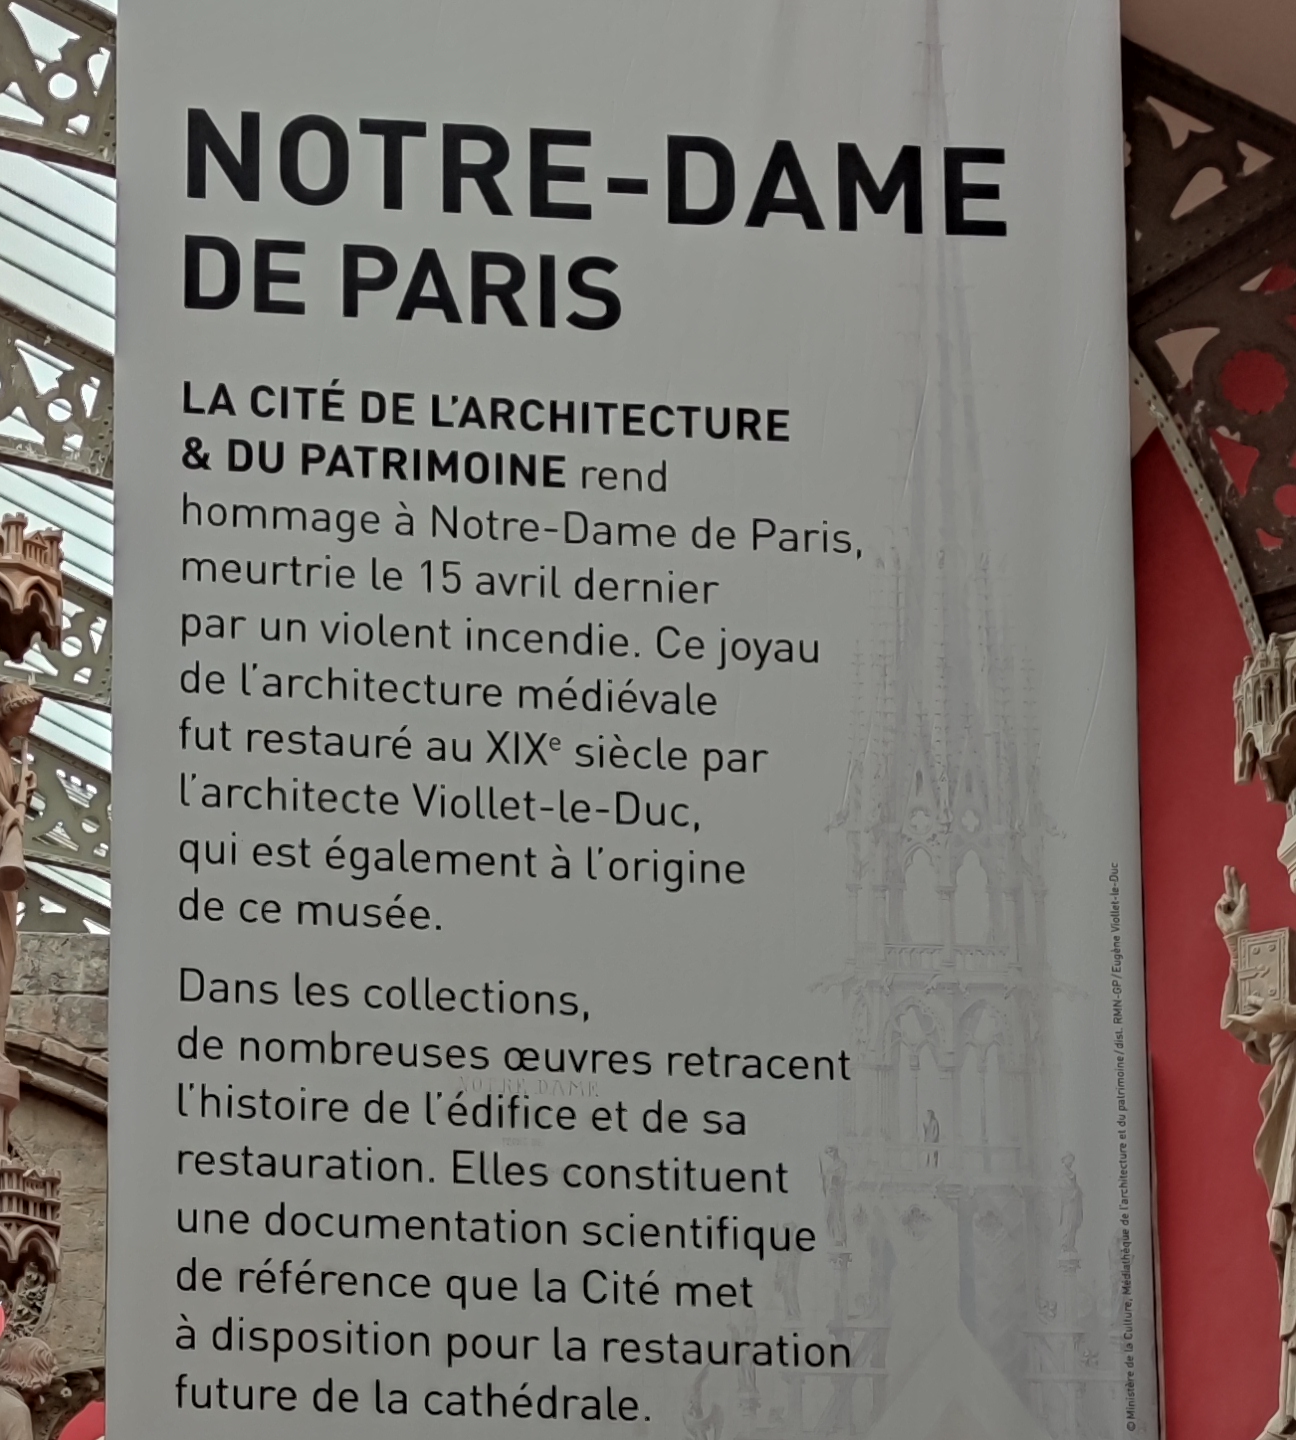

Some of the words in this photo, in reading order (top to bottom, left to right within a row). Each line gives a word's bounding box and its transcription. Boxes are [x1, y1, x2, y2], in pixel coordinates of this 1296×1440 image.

[187, 108, 1007, 237] NOTRE-DAME
[184, 234, 306, 315] DE
[342, 243, 622, 331] PARIS
[183, 380, 237, 416] LA
[250, 378, 345, 422] CITÉ
[361, 390, 415, 426] DE
[431, 394, 790, 442] L'ARCHITECTURE
[181, 436, 212, 471] &
[228, 438, 284, 474] DU
[301, 443, 566, 488] PATRIMOINE
[581, 459, 667, 492] rend
[182, 491, 380, 543] hommage
[395, 501, 414, 537] à
[432, 504, 677, 548] Notre-Dame
[691, 516, 736, 550] de
[752, 518, 862, 560] Paris,
[182, 554, 355, 589] meurtrie
[371, 556, 403, 591] le
[420, 559, 461, 594] 15
[475, 565, 561, 599] avril
[574, 567, 720, 605] dernier
[181, 613, 247, 647] par
[261, 617, 306, 643] un
[320, 611, 451, 650] violent
[466, 622, 640, 658] incendie.
[656, 625, 705, 660] Ce
[717, 637, 819, 671] joyau
[180, 660, 225, 695] de
[241, 662, 503, 708] l'architecture
[518, 675, 717, 716] médiévale
[178, 716, 232, 752] fut
[247, 724, 412, 760] restauré
[426, 737, 472, 763] au
[575, 733, 688, 771] siècle
[704, 748, 769, 782] par
[180, 772, 399, 816] l'architecte
[412, 783, 700, 833] Viollet-le-Duc,
[179, 839, 236, 874] qui
[252, 837, 311, 869] est
[325, 834, 537, 881] également
[550, 843, 570, 879] à
[587, 846, 745, 893] l'origine
[178, 886, 224, 922] de
[239, 898, 282, 924] ce
[297, 893, 442, 931] musée.
[1109, 862, 1121, 933] Viollet-le-Duc
[180, 967, 279, 1005] Dans
[294, 971, 350, 1008] les
[364, 976, 589, 1023] collections,
[177, 1025, 224, 1060] de
[240, 1030, 490, 1070] nombreuses
[504, 1046, 652, 1076] œuvres
[667, 1046, 851, 1081] retracent
[178, 1082, 349, 1123] l'histoire
[364, 1089, 410, 1125] de
[425, 1090, 577, 1131] l'édifice
[591, 1101, 628, 1133] et
[642, 1099, 688, 1134] de
[703, 1110, 746, 1136] sa
[1116, 1114, 1127, 1127] du
[1117, 1129, 1127, 1140] et
[178, 1145, 435, 1183] restauration.
[452, 1149, 549, 1187] Elles
[563, 1159, 789, 1194] constituent
[1118, 1142, 1129, 1210] l'architecture
[177, 1208, 250, 1235] une
[265, 1201, 567, 1246] documentation
[582, 1215, 816, 1261] scientifique
[1120, 1213, 1130, 1226] de
[176, 1256, 223, 1293] de
[239, 1257, 431, 1299] référence
[446, 1275, 518, 1311] que
[534, 1267, 566, 1304] la
[582, 1269, 660, 1306] Cité
[675, 1276, 753, 1309] met
[1121, 1228, 1132, 1295] Médiathèque
[175, 1313, 196, 1350] à
[212, 1316, 430, 1363] disposition
[447, 1333, 540, 1368] pour
[553, 1326, 586, 1362] la
[603, 1332, 851, 1369] restauration
[1123, 1298, 1134, 1340] Culture,
[1124, 1342, 1134, 1352] la
[1124, 1355, 1134, 1368] de
[175, 1373, 297, 1412] future
[312, 1377, 359, 1413] de
[375, 1378, 408, 1415] la
[424, 1382, 651, 1422] cathédrale.
